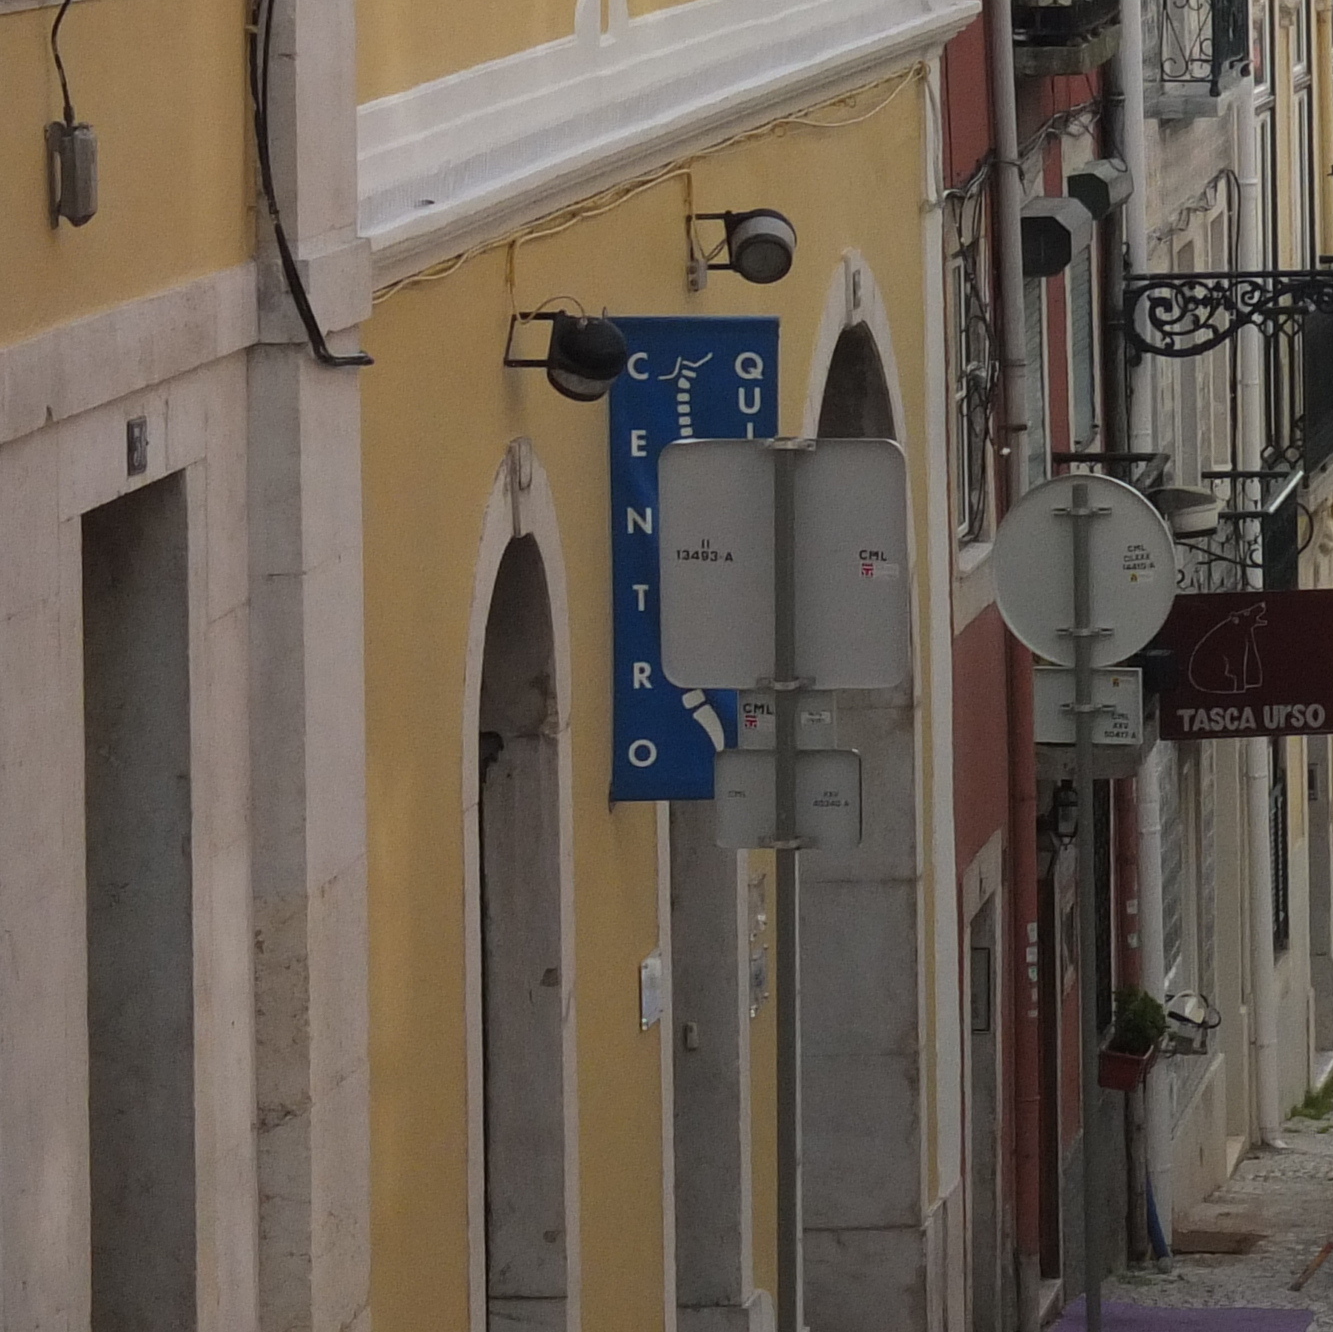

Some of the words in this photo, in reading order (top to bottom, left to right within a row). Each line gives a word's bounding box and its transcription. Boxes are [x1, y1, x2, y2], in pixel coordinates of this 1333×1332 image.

[627, 351, 658, 768] CENTRO
[859, 549, 887, 562] CML
[742, 702, 774, 715] CML
[1176, 706, 1257, 732] TASCA
